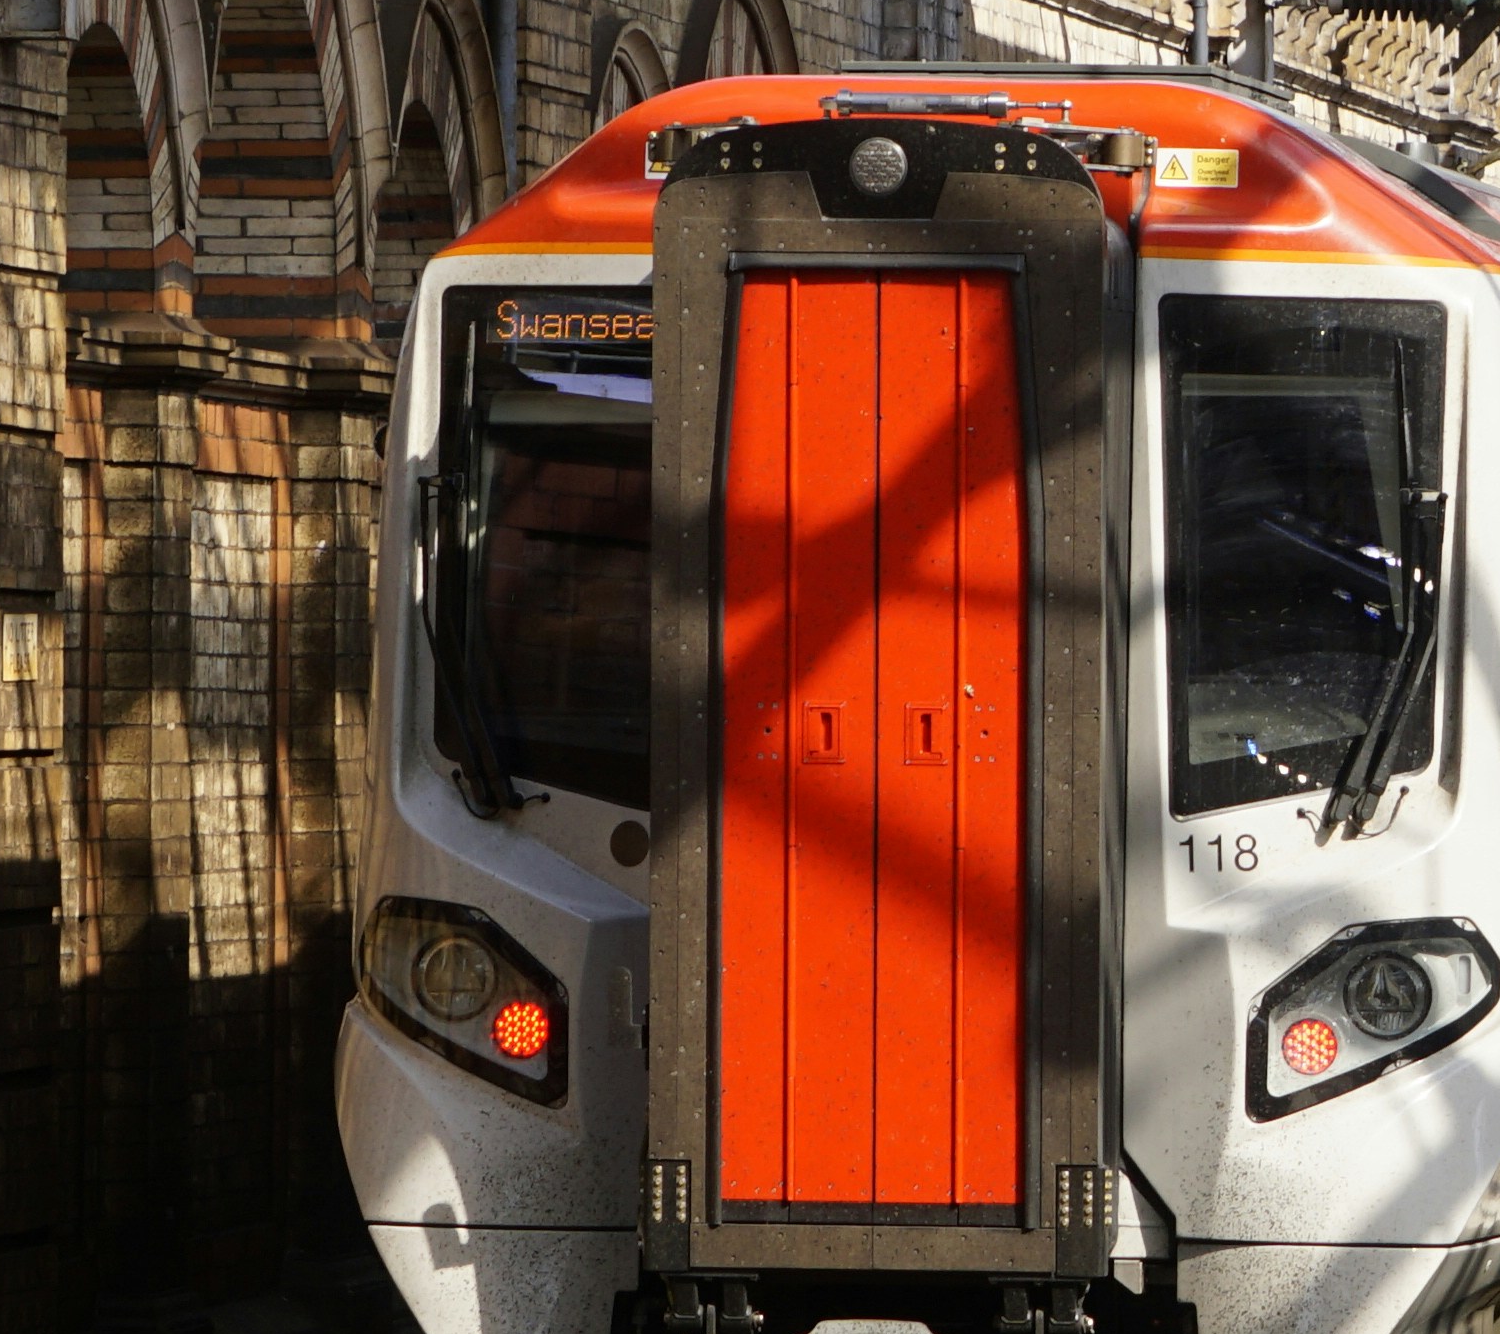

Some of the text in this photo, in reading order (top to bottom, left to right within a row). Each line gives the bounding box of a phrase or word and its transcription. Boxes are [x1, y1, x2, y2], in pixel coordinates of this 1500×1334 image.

[1196, 155, 1231, 166] Danger
[495, 299, 654, 340] Swansea
[1179, 834, 1259, 873] 118
